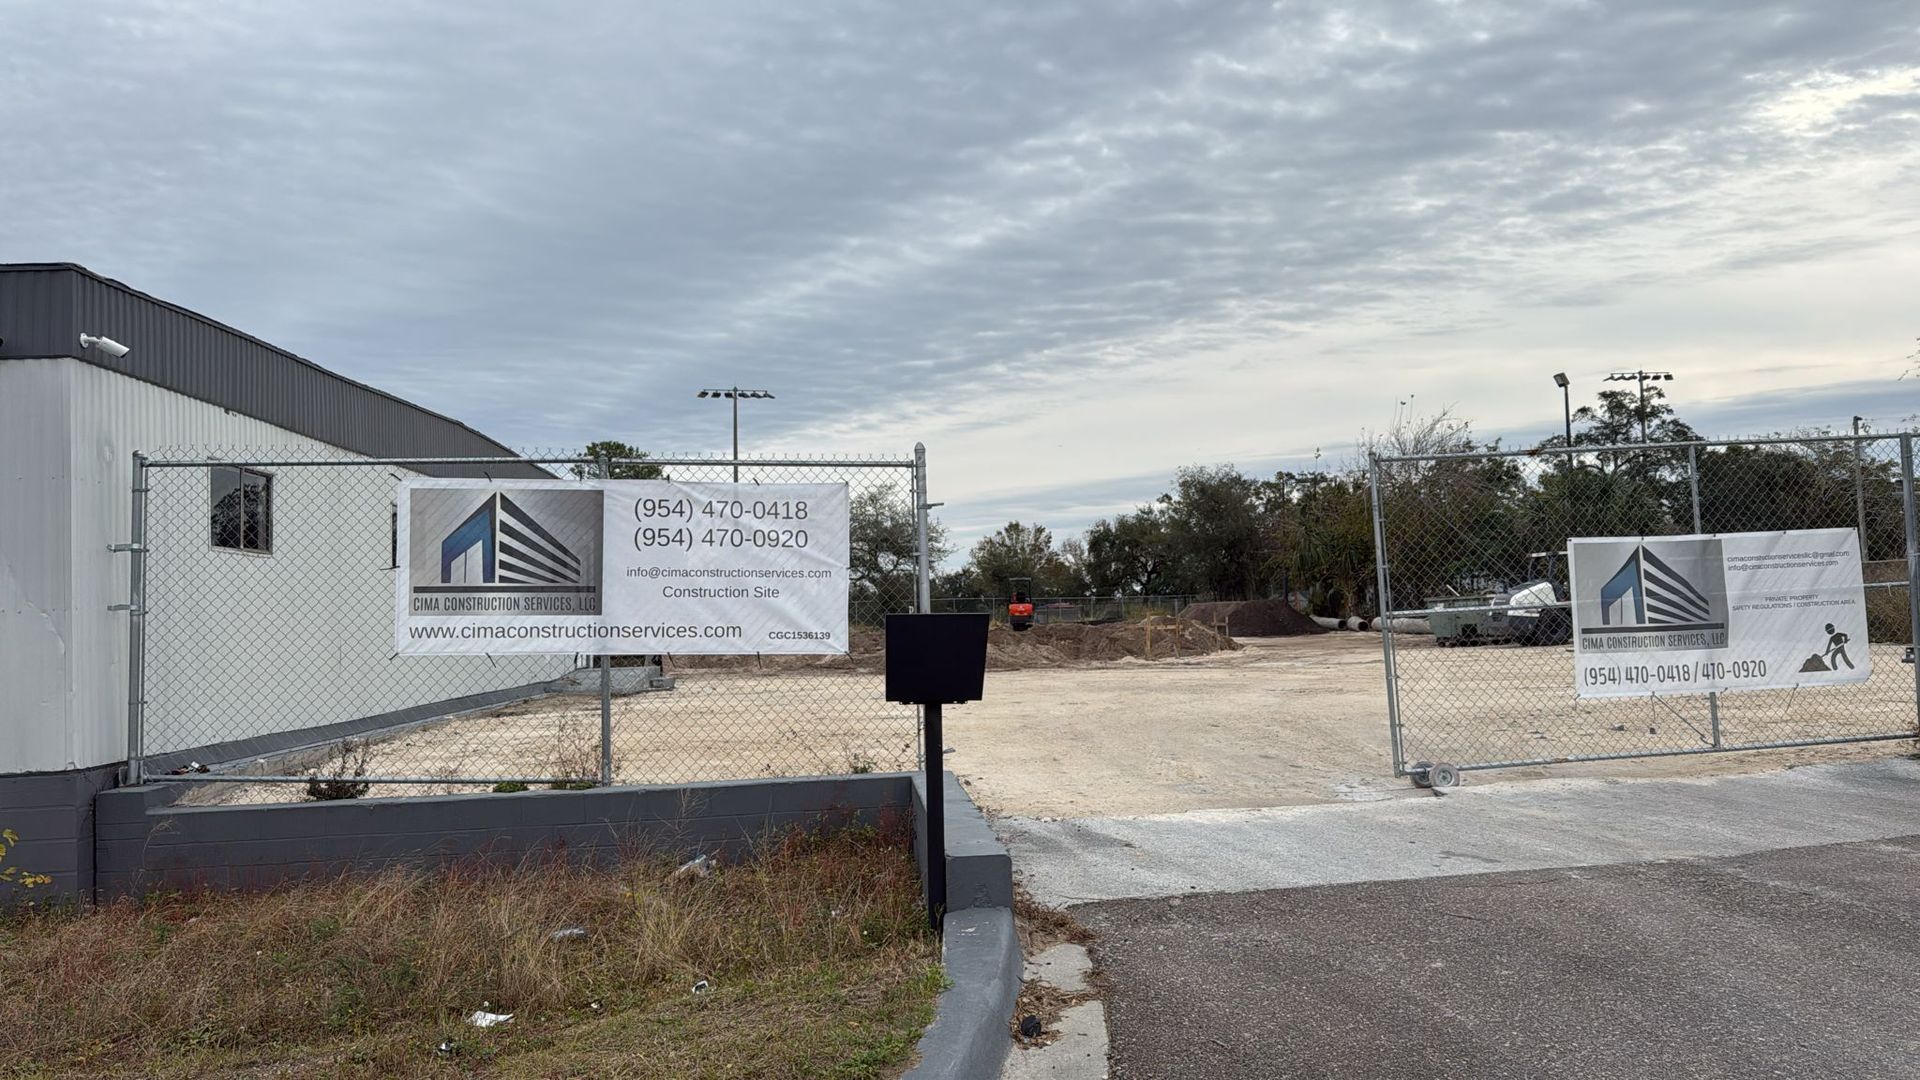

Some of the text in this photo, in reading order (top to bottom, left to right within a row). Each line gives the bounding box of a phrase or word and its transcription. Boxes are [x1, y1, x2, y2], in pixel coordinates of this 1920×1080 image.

[634, 498, 808, 522] (954) 470-0418
[634, 527, 808, 551] (954) 470-0920
[626, 567, 832, 579] info@cimaconstructionservices.com
[662, 586, 780, 599] Construction Site
[413, 597, 596, 612] CIMA CONSTRUCTION SERVICES, LLC
[1752, 602, 1793, 610] REGULATIONS
[1796, 600, 1840, 608] CONSTRUCTION
[409, 622, 742, 640] www.cimaconstructionservices.com
[768, 631, 831, 640] CGC1536139
[1582, 632, 1725, 650] CIMA CONSTRUCTION SERVICES, LLC
[1584, 666, 1622, 687] (954)
[1625, 664, 1690, 684] 470-0418
[1702, 660, 1767, 680] 470-0920
